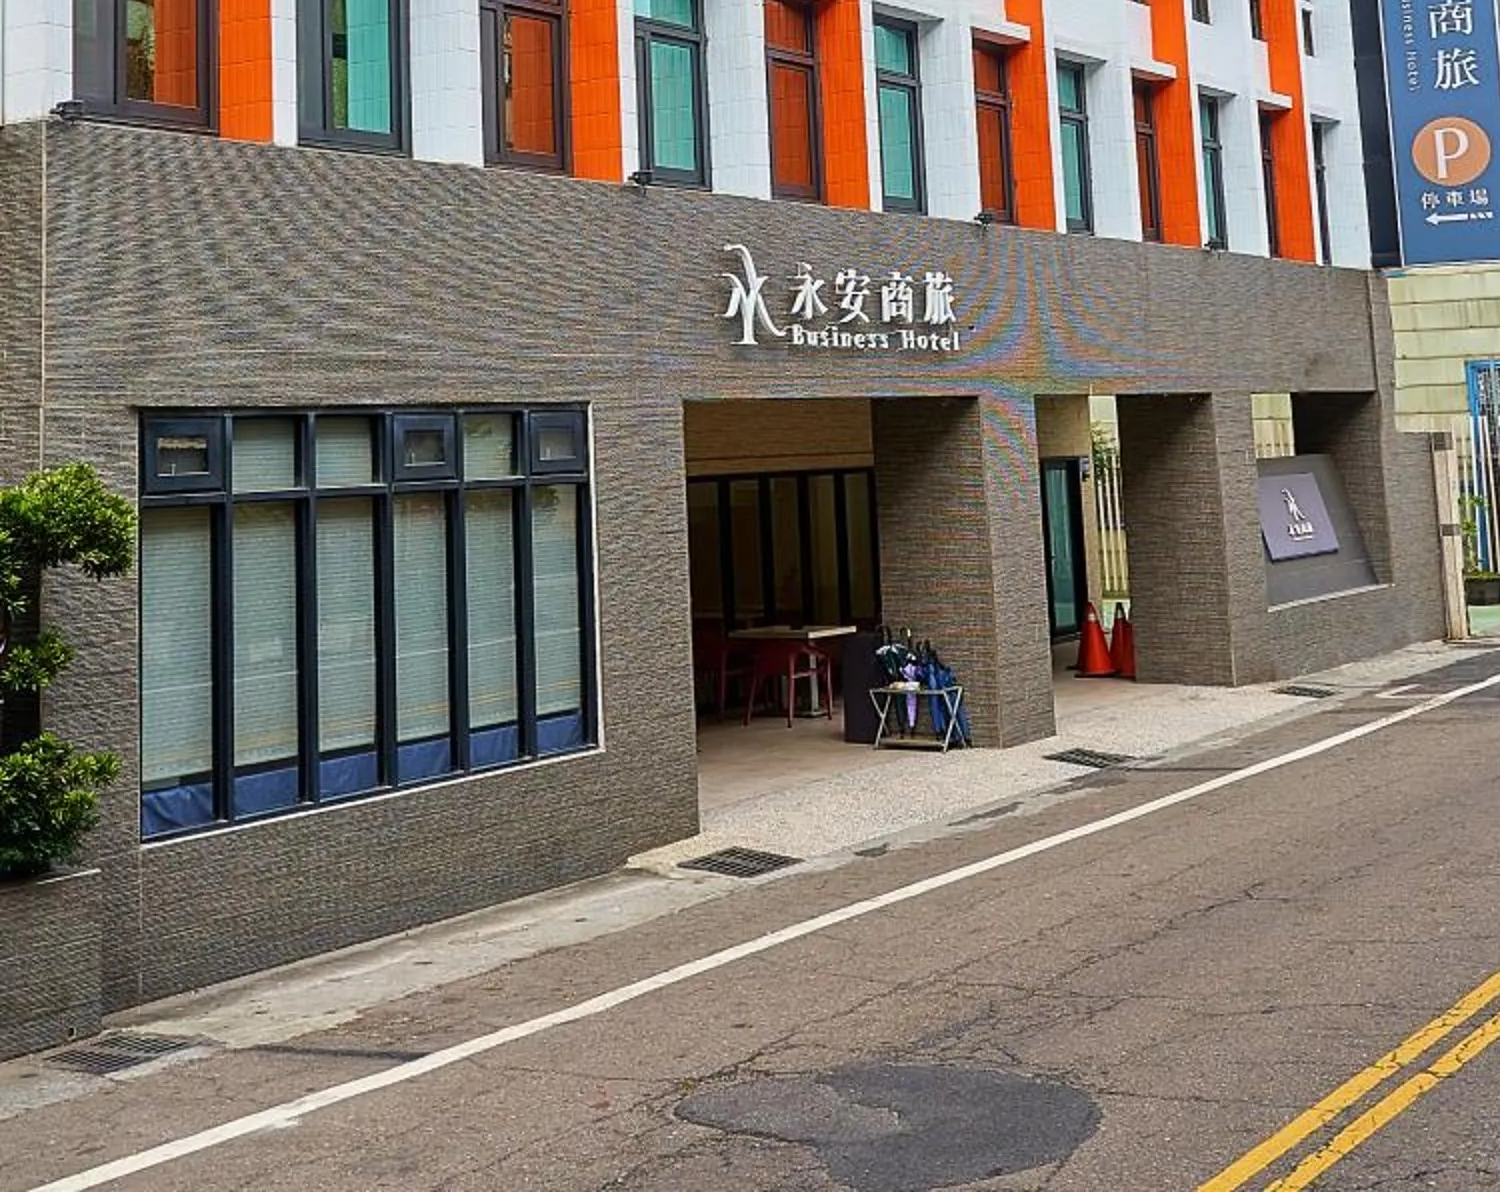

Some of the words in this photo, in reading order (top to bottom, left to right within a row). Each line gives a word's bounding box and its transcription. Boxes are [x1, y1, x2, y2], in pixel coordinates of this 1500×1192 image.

[1433, 127, 1469, 179] P
[1421, 189, 1489, 210] 停車場
[791, 262, 957, 325] 永安商旅
[792, 324, 889, 349] Business
[901, 329, 961, 351] Hotel
